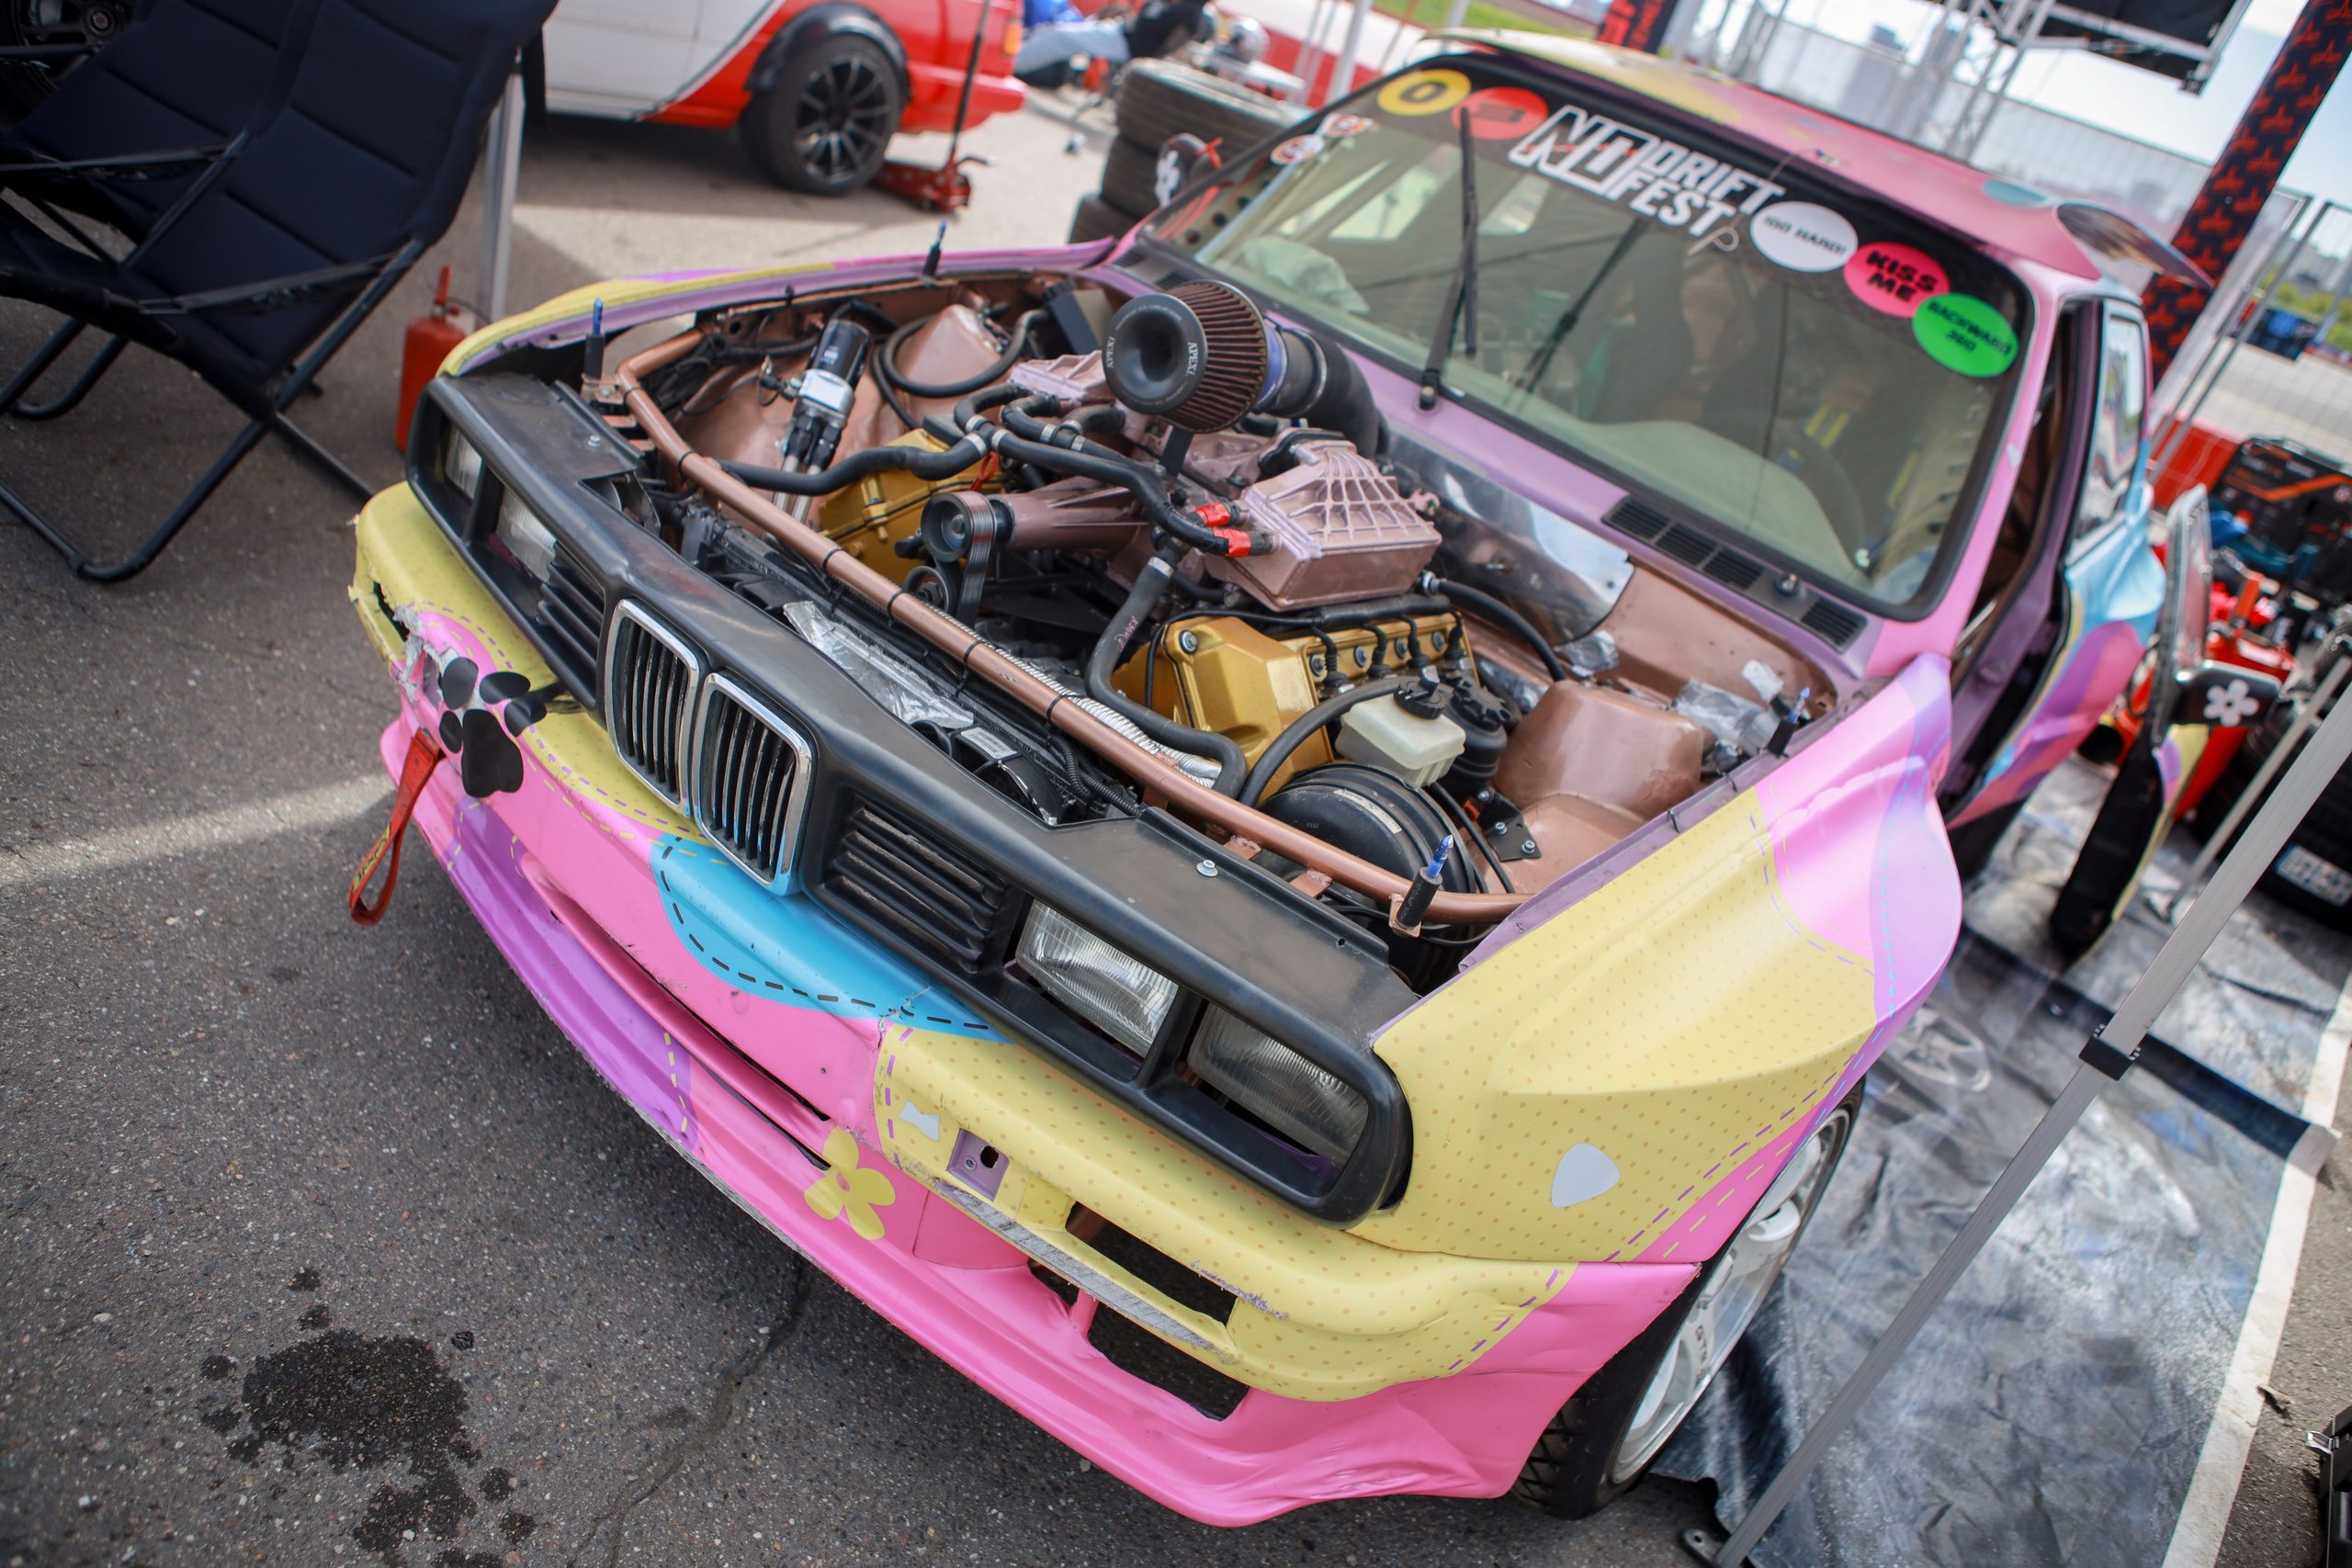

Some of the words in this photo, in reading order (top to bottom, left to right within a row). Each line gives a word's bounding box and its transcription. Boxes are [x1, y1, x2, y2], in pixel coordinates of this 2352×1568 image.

[1606, 169, 1736, 236] FEST
[1640, 141, 1786, 215] DRIFT
[1867, 250, 1939, 294] KISS
[1867, 273, 1917, 304] ME
